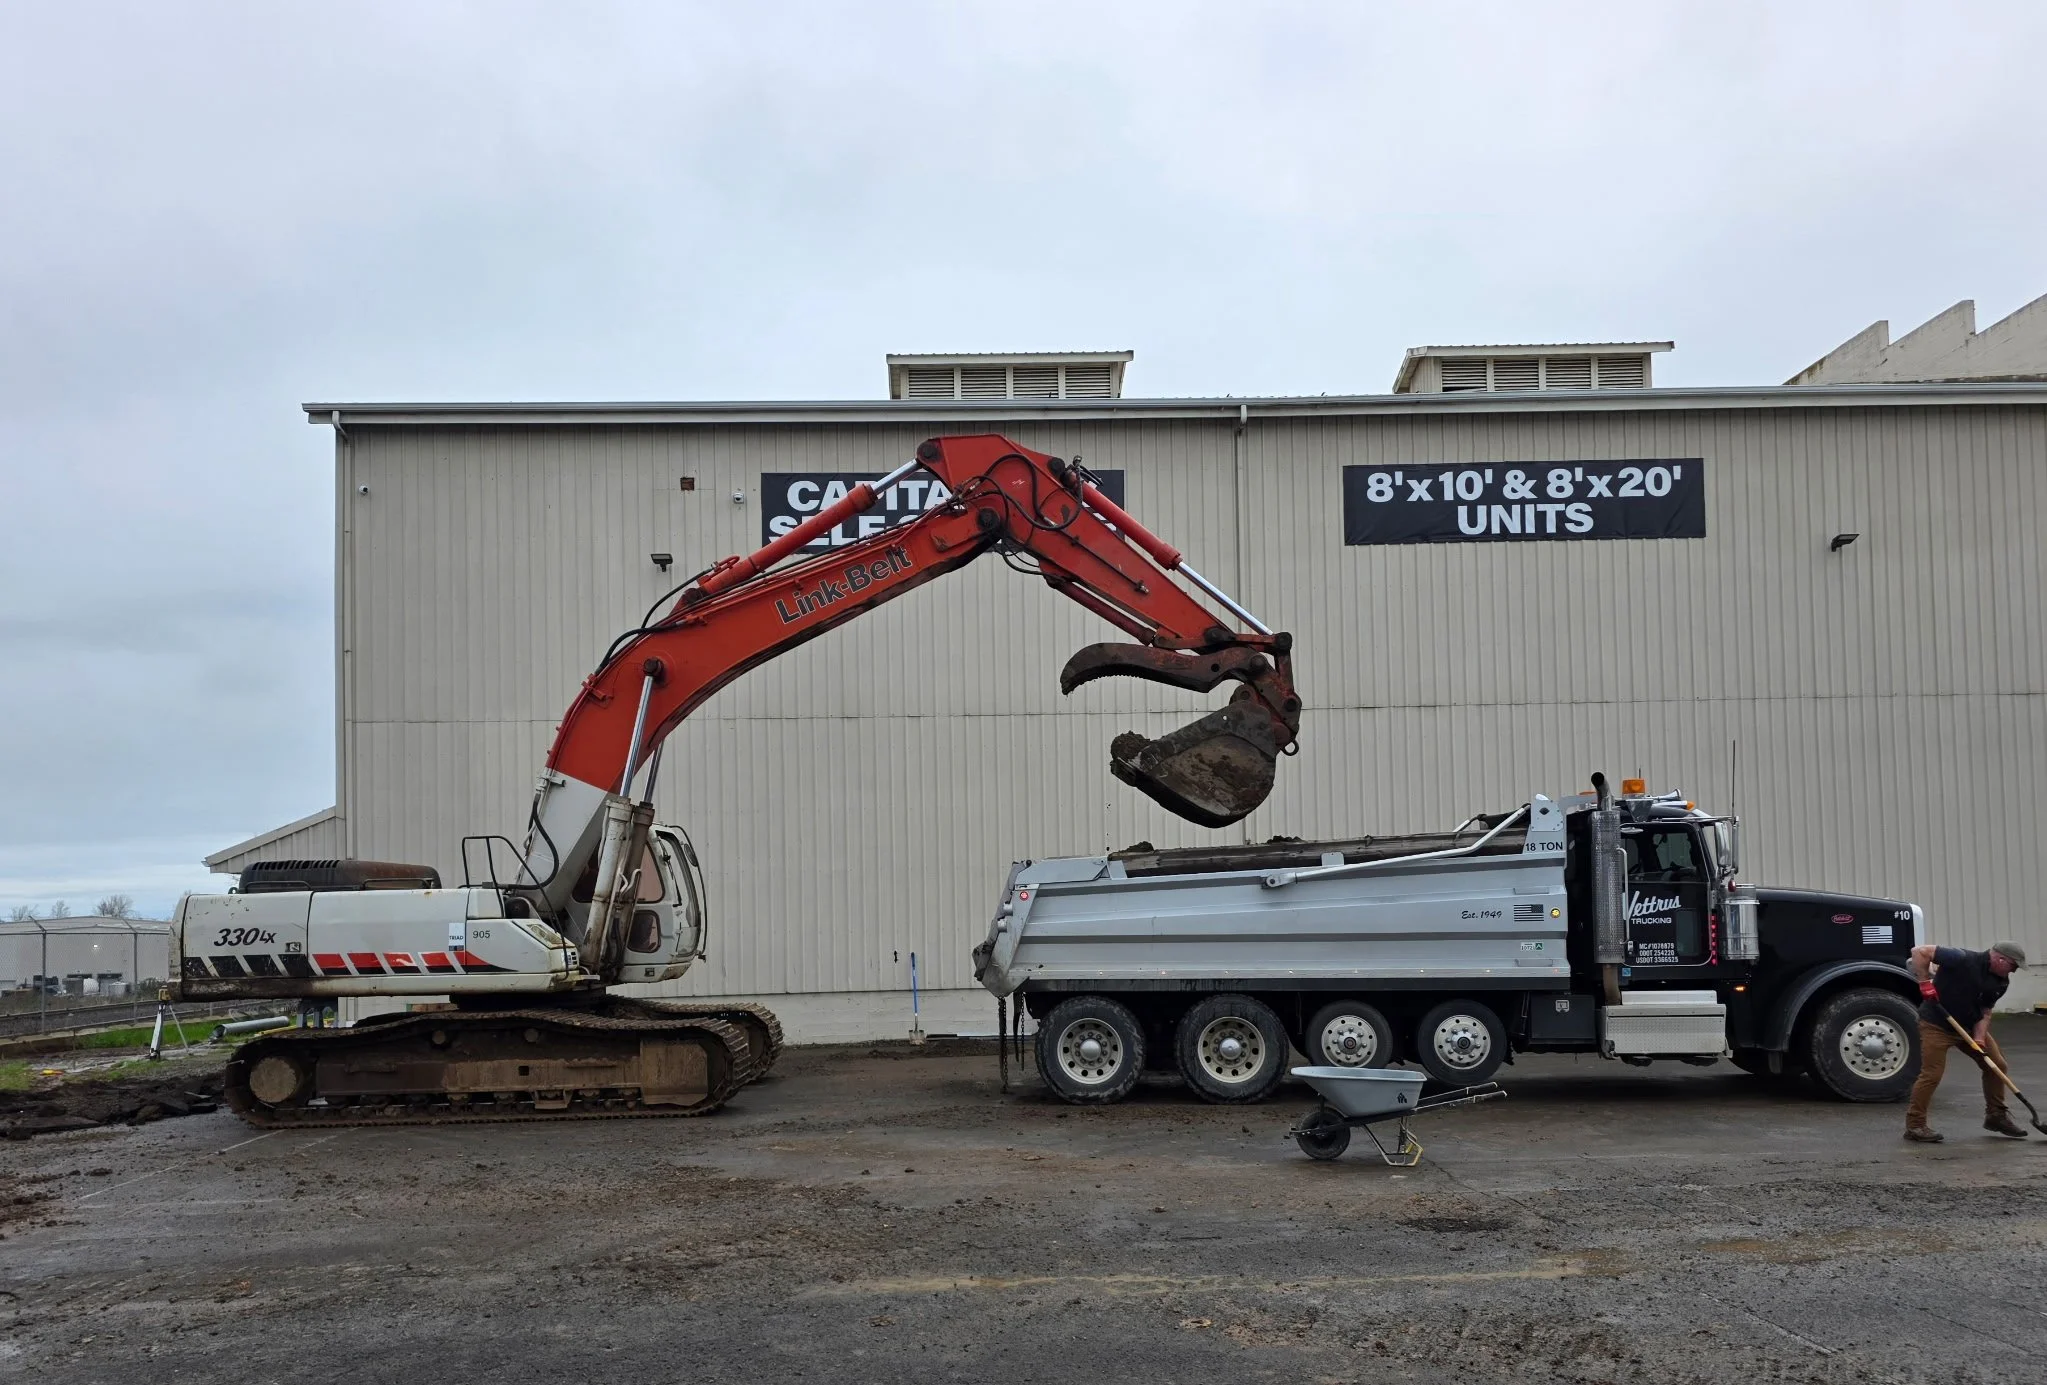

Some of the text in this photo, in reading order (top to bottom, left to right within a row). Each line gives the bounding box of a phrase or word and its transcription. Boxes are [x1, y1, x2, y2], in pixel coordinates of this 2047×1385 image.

[1502, 469, 1538, 500] &
[787, 480, 955, 512] CAITA
[1457, 502, 1594, 535] UNITS
[774, 545, 912, 625] Link-Belt
[1525, 842, 1563, 852] 18 TON
[1461, 910, 1502, 919] Est. 1949
[1622, 890, 1681, 920] Vettrus
[1894, 910, 1910, 920] #10
[472, 930, 491, 939] 905
[1635, 956, 1653, 964] USDOT
